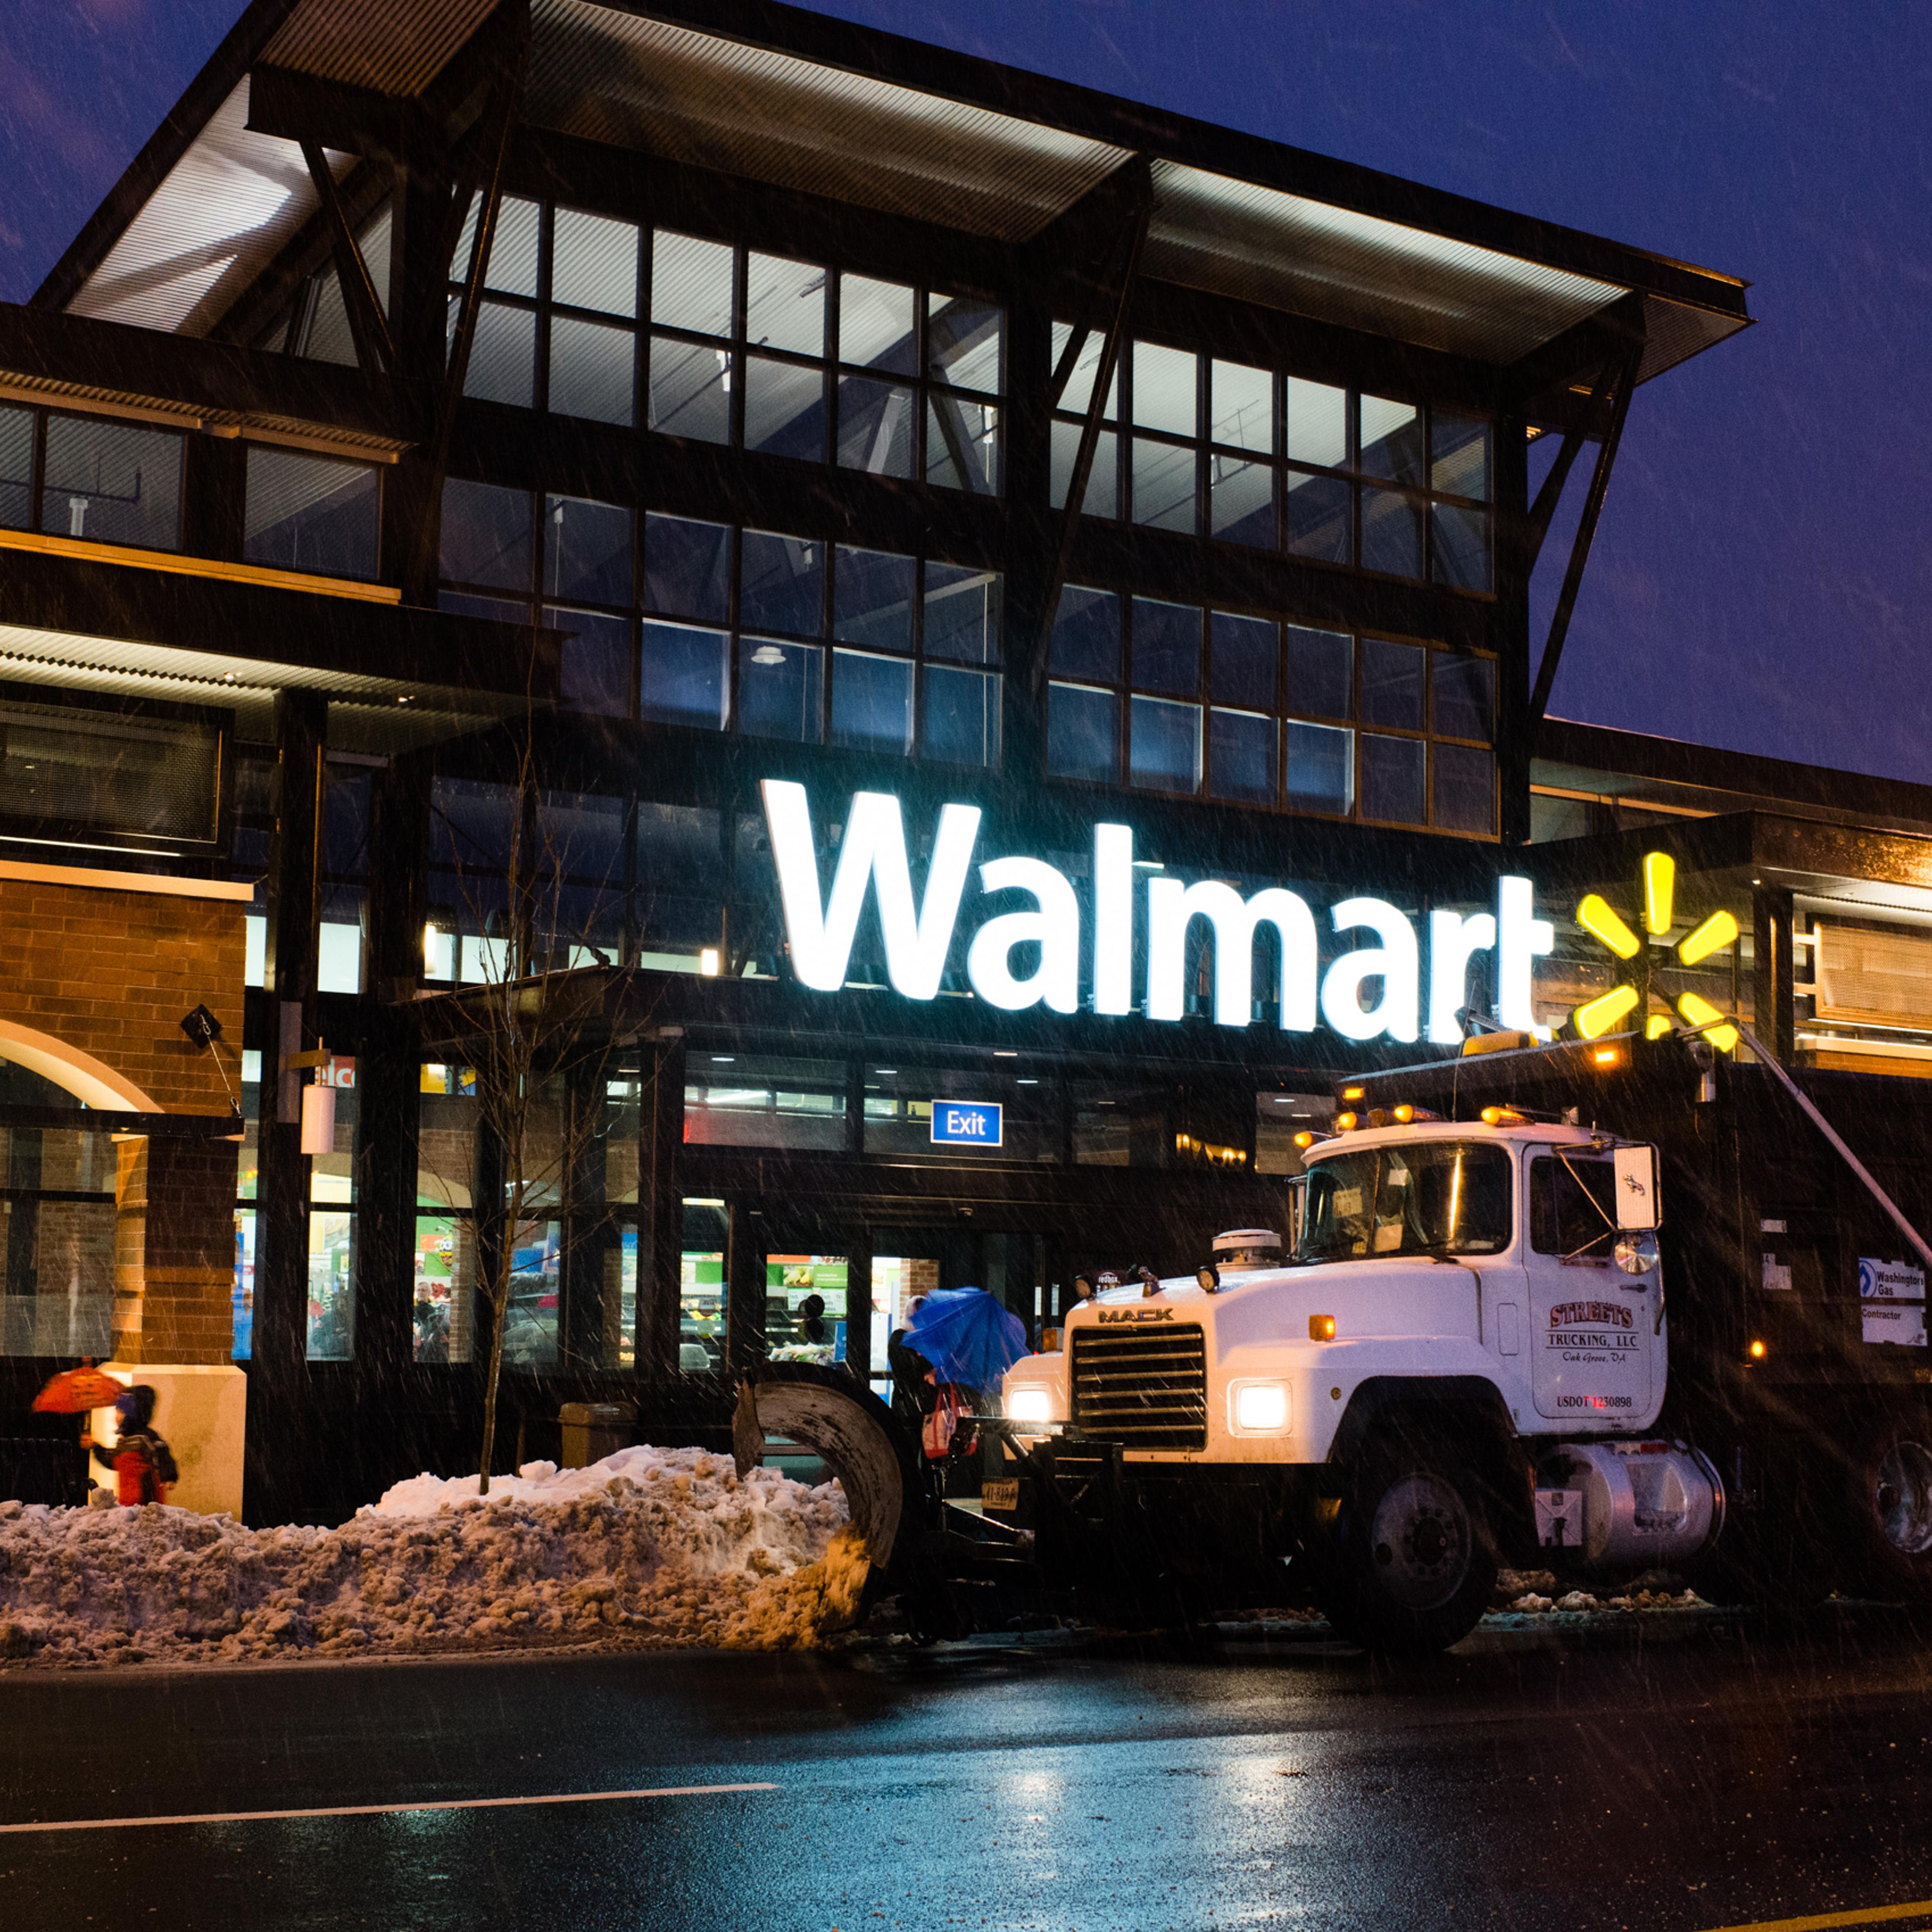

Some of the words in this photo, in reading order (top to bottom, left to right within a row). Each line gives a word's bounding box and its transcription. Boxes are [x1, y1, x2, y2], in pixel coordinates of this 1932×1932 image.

[760, 779, 1554, 1044] Walmart
[947, 1110, 986, 1136] Exit
[1098, 1275, 1117, 1283] redbox
[1878, 1284, 1893, 1296] Gas
[1098, 1308, 1174, 1323] MACK
[1550, 1301, 1633, 1328] STREETS
[1862, 1309, 1901, 1320] Contractor
[1548, 1334, 1610, 1347] TRUCKING,
[1617, 1336, 1636, 1346] LLC
[1563, 1352, 1581, 1361] Oak
[1583, 1353, 1608, 1363] Grove,
[1610, 1353, 1626, 1364] VA
[1557, 1396, 1589, 1407] USDOT
[1592, 1396, 1632, 1408] 1230898
